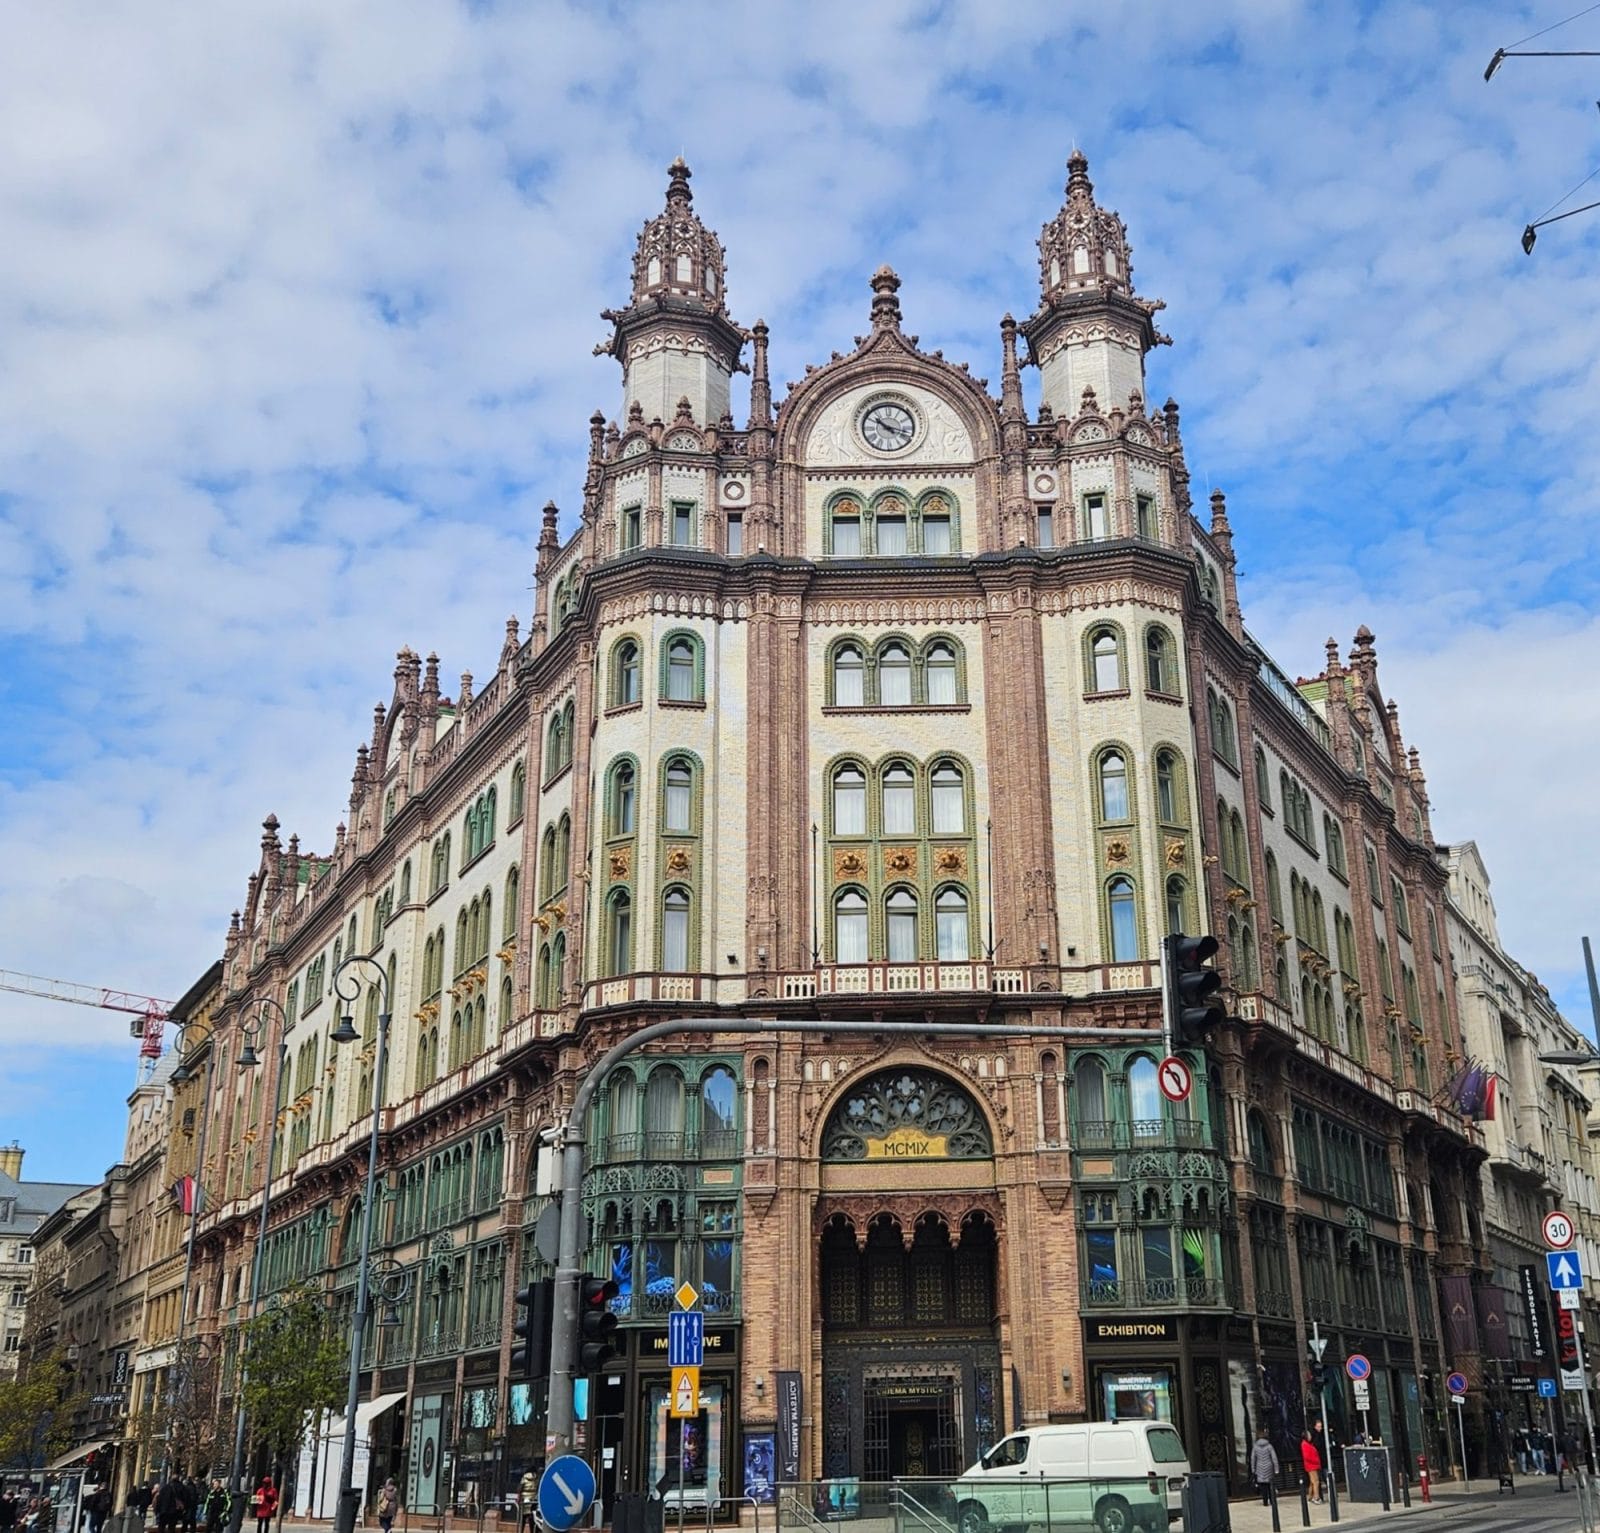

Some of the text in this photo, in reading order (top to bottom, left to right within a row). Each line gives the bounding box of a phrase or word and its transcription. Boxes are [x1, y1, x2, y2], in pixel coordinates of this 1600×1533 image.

[884, 1142, 929, 1156] MCMIX
[1551, 1223, 1566, 1238] 30
[1098, 1324, 1166, 1336] EXHIBITION
[654, 1336, 721, 1349] IMIVE
[1543, 1382, 1551, 1394] P
